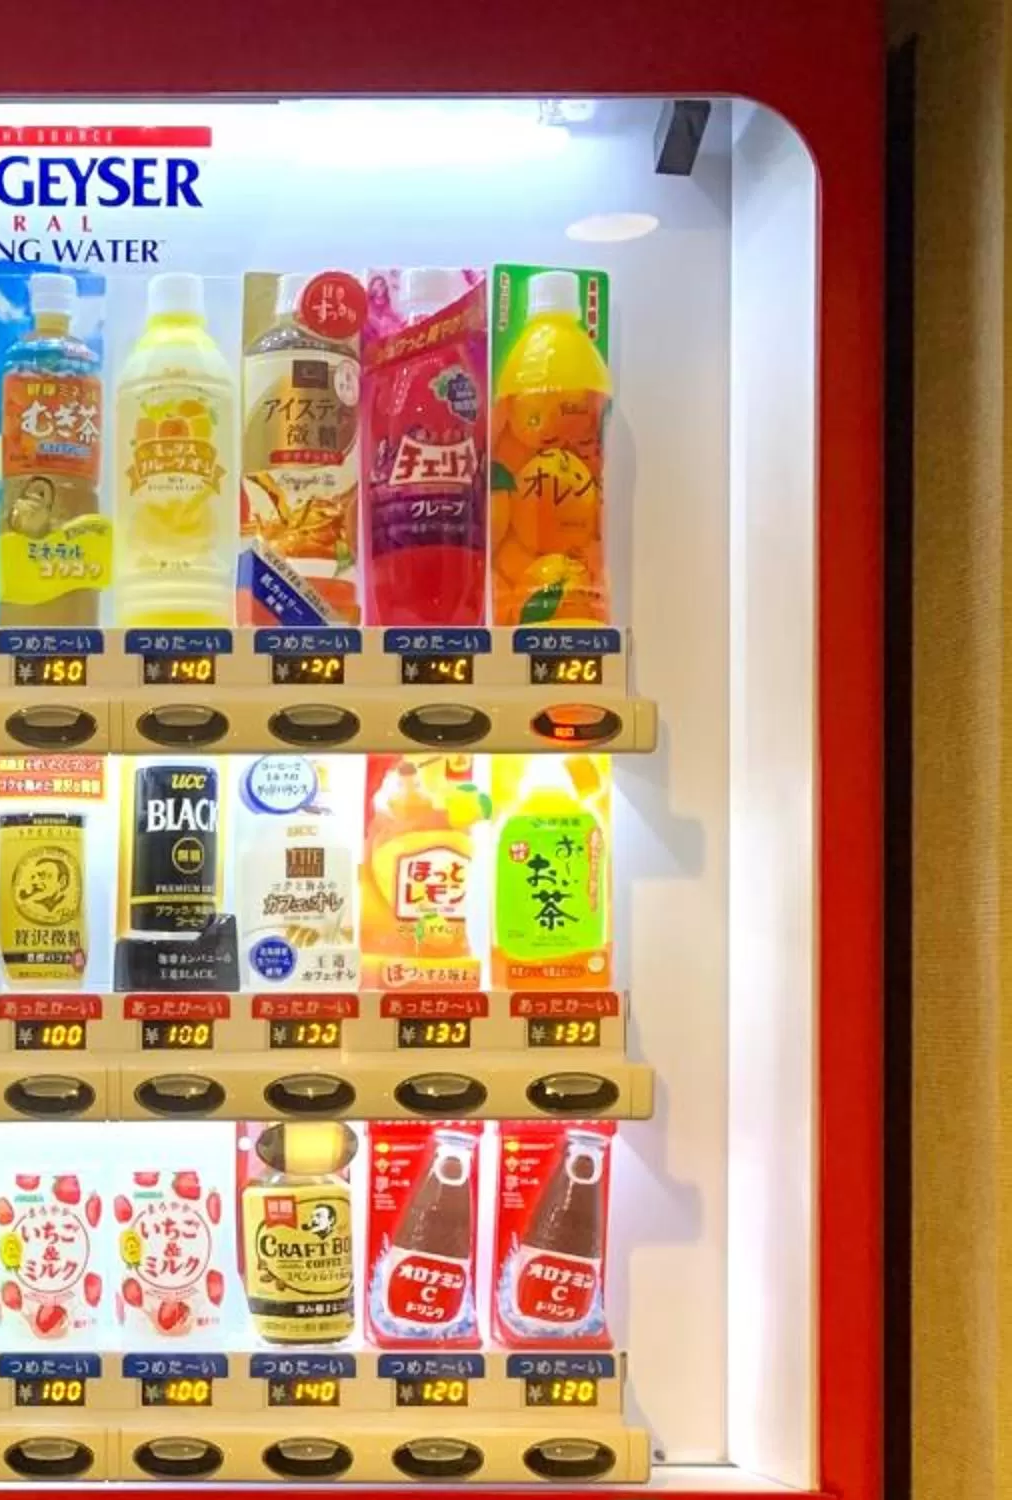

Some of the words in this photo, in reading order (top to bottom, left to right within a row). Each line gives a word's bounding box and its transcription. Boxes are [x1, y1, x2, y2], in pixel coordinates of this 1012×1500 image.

[37, 129, 115, 144] SOURCE
[59, 238, 160, 263] WATER
[19, 399, 101, 445] むぎ茶
[407, 860, 466, 883] ほっと
[404, 883, 466, 905] レモン
[525, 853, 580, 931] お茶
[20, 1221, 81, 1245] いちご
[139, 1217, 201, 1241] いちご
[43, 1245, 61, 1262] &
[163, 1242, 182, 1258] &
[259, 1234, 331, 1258] CRAFT
[23, 1260, 79, 1282] ミルク
[144, 1256, 201, 1279] ミルク
[396, 1263, 464, 1289] オロナミン
[526, 1263, 595, 1289] オロナミン
[419, 1286, 438, 1302] C
[550, 1286, 569, 1302] C
[405, 1302, 446, 1318] ドリンク
[535, 1302, 577, 1318] ドリンク
